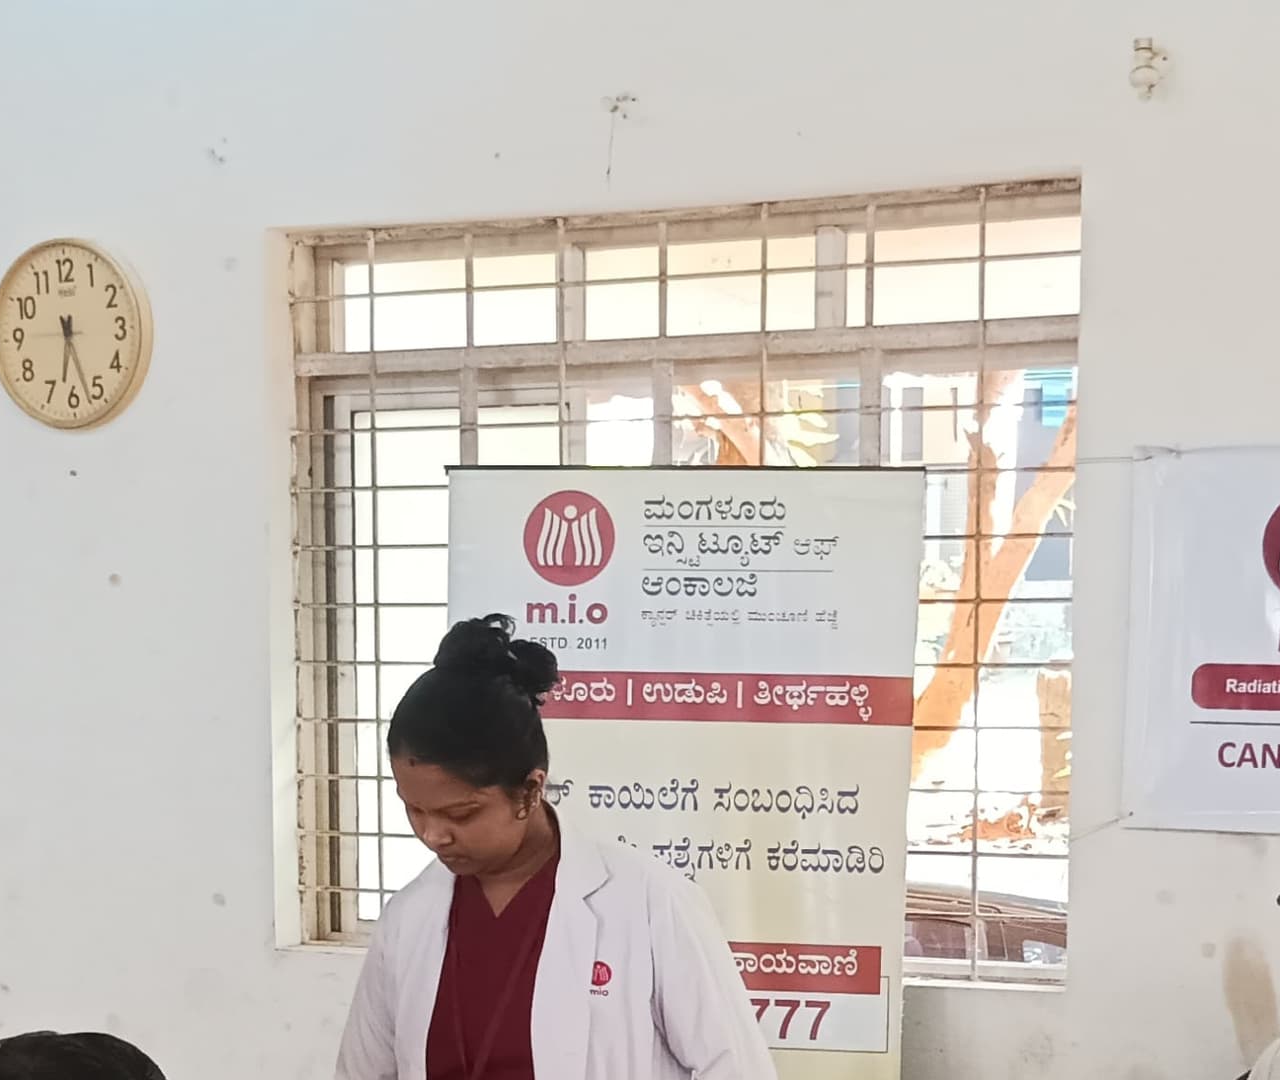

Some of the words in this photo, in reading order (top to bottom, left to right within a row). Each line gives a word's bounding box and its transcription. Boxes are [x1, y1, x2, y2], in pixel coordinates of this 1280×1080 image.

[34, 270, 49, 295] 11
[56, 258, 74, 283] 12
[87, 263, 94, 287] 1
[16, 296, 36, 320] 10
[105, 284, 118, 308] 2
[12, 328, 24, 351] 9
[114, 316, 127, 341] 3
[22, 358, 34, 382] 8
[109, 349, 122, 373] 4
[44, 380, 56, 404] 7
[68, 385, 80, 409] 6
[91, 375, 104, 400] 5
[643, 495, 786, 520] ಮಂಗಳೂರು
[641, 573, 758, 597] ಆಂಕಾಲಜಿ
[526, 593, 608, 625] m.i.o
[577, 637, 607, 650] 2011
[642, 678, 728, 704] ಉಡುಪಿ
[588, 778, 699, 811] ಕಾಯಿಲೆಗೆ
[713, 781, 860, 820] ಸಂಬಂಧಿಸಿದ
[767, 839, 885, 875] ಕರೆಮಾಡಿರಿ
